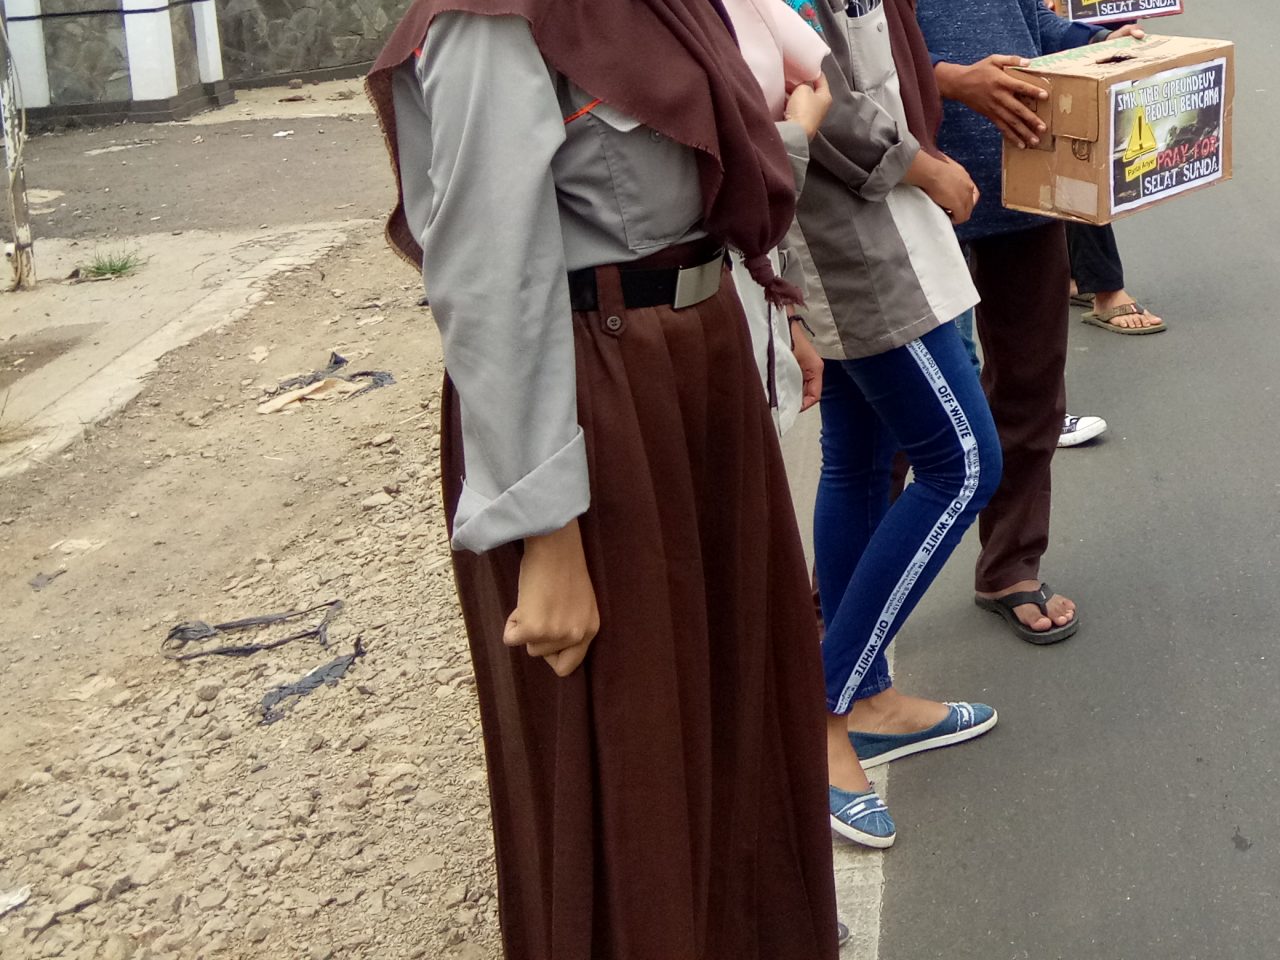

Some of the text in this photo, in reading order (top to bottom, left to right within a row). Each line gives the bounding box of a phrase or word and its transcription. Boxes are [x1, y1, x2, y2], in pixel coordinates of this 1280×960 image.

[1101, 0, 1134, 15] SELAT
[1117, 91, 1137, 111] SMK
[1162, 71, 1216, 100] CIPEUNDEUY
[1145, 87, 1220, 123] PEDULI BENCANA
[1157, 136, 1218, 170] PRAY FOR
[1144, 155, 1219, 194] SELAT SUNDA
[938, 385, 972, 440] OFF-WHITE
[921, 501, 963, 556] OFF-WHITE
[854, 619, 889, 679] OFF-WHITE
